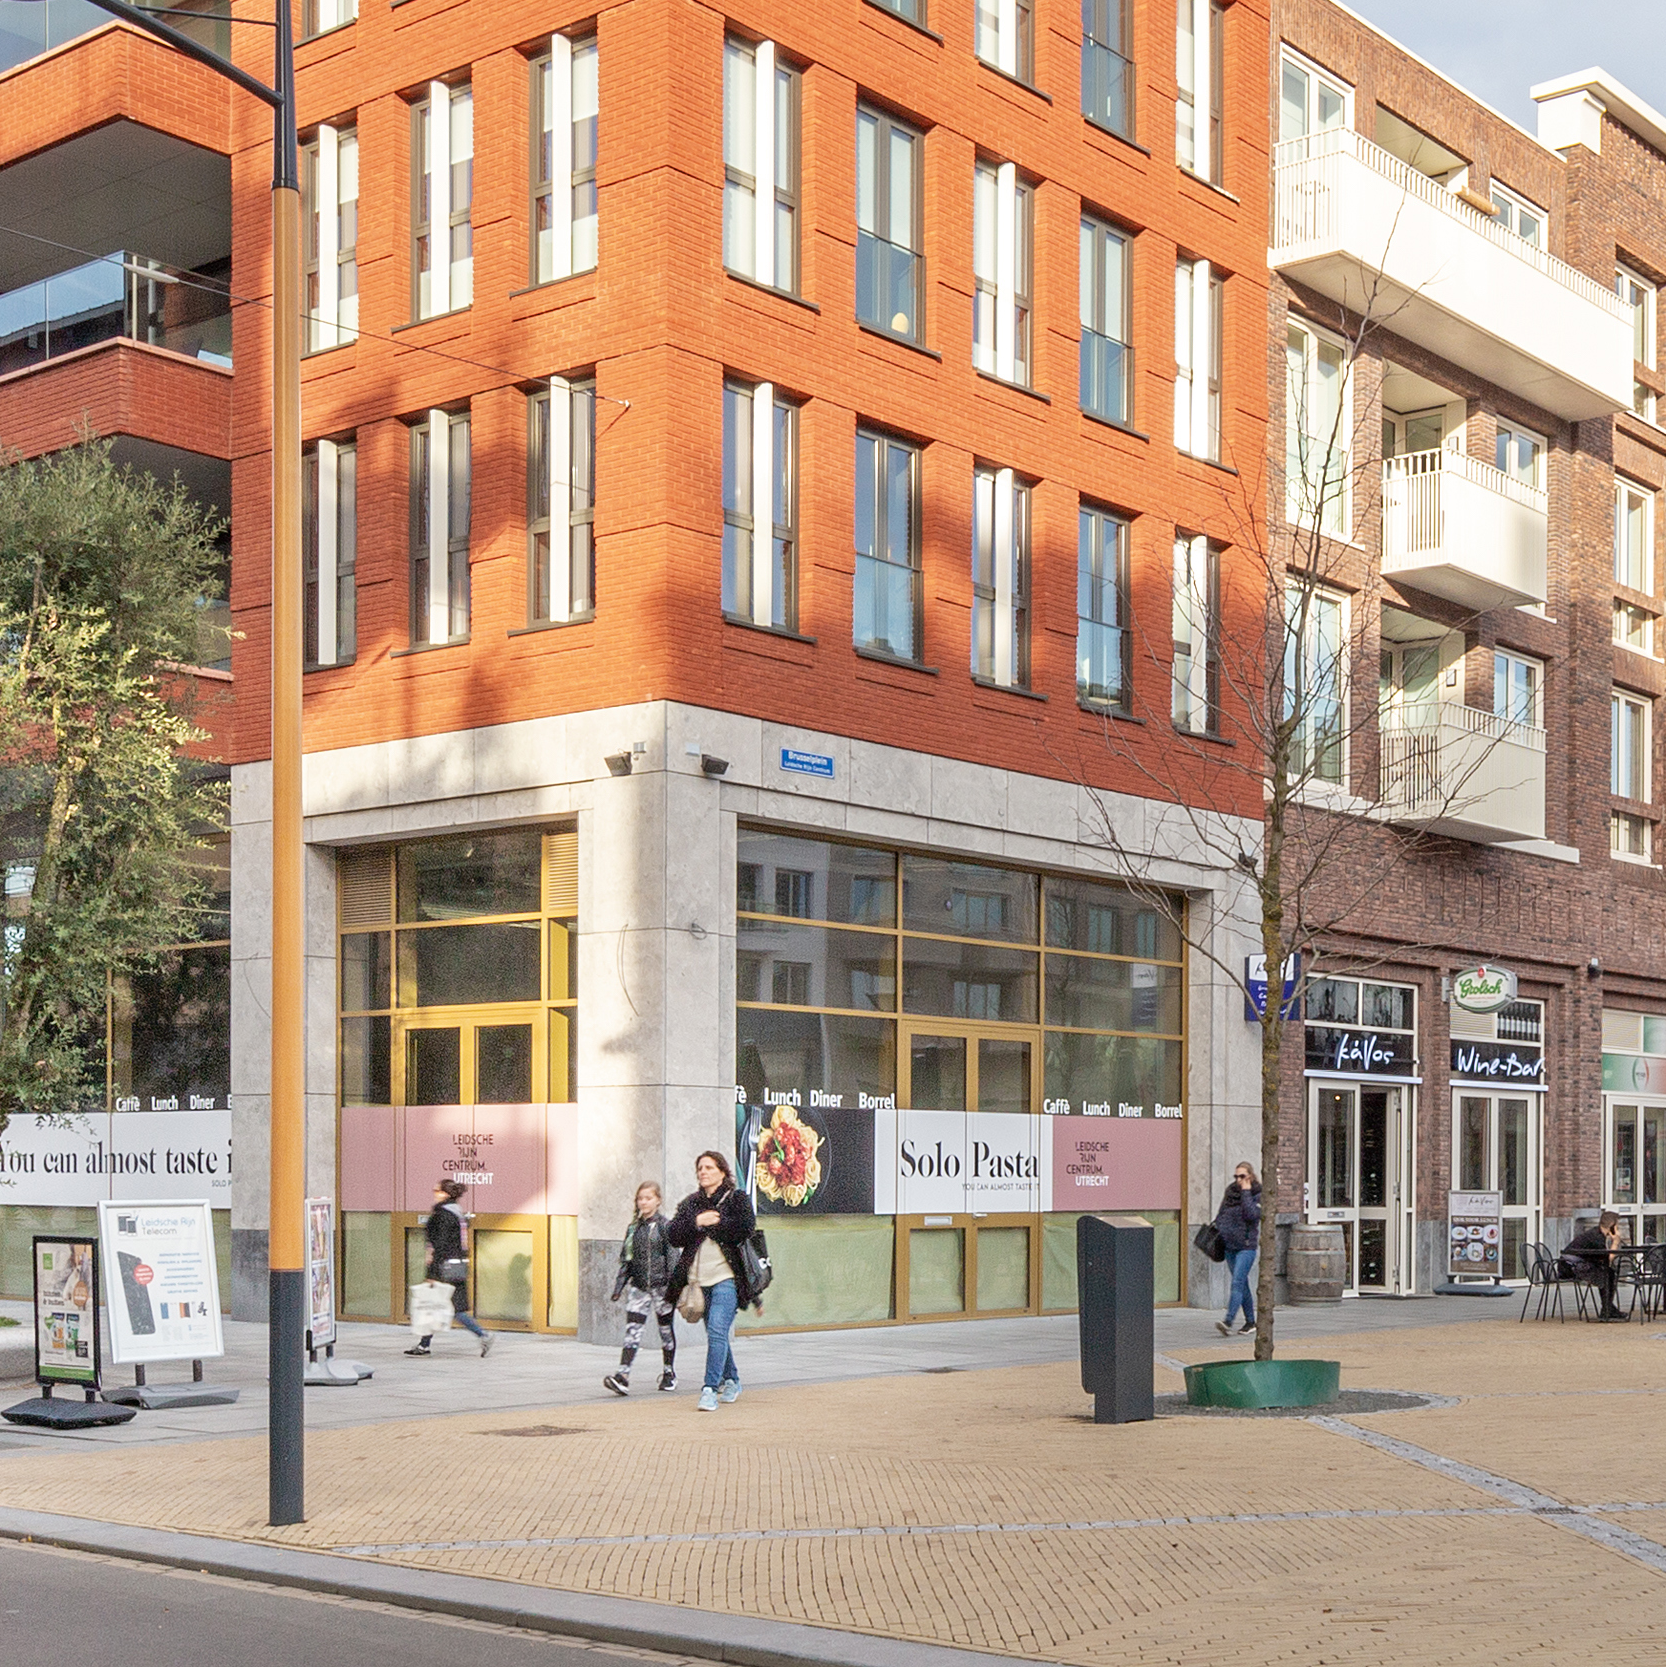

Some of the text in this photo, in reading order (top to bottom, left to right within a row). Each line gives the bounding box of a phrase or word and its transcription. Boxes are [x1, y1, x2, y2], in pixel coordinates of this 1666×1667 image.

[1459, 977, 1503, 999] Grolsch
[115, 1096, 141, 1112] Caffè
[151, 1094, 179, 1111] Lunch
[190, 1094, 216, 1110] Diner
[764, 1087, 801, 1106] Lunch
[810, 1089, 843, 1107] Diner
[858, 1092, 896, 1109] Borrel
[1043, 1098, 1183, 1118] Caffè Lunch Diner Borrel
[453, 1134, 494, 1145] LEIDSCHE
[1075, 1142, 1110, 1152] LEIDSCHE
[44, 1151, 78, 1174] can
[85, 1141, 157, 1174] almost
[166, 1148, 218, 1174] taste
[901, 1139, 1039, 1178] Solo Pasta
[453, 1172, 494, 1185] UTRECHT
[1075, 1176, 1110, 1186] UTRECHT
[977, 1183, 989, 1191] CAN
[990, 1183, 1013, 1191] ALMOST
[141, 1218, 179, 1227] Leidsche
[142, 1227, 178, 1235] Telecom
